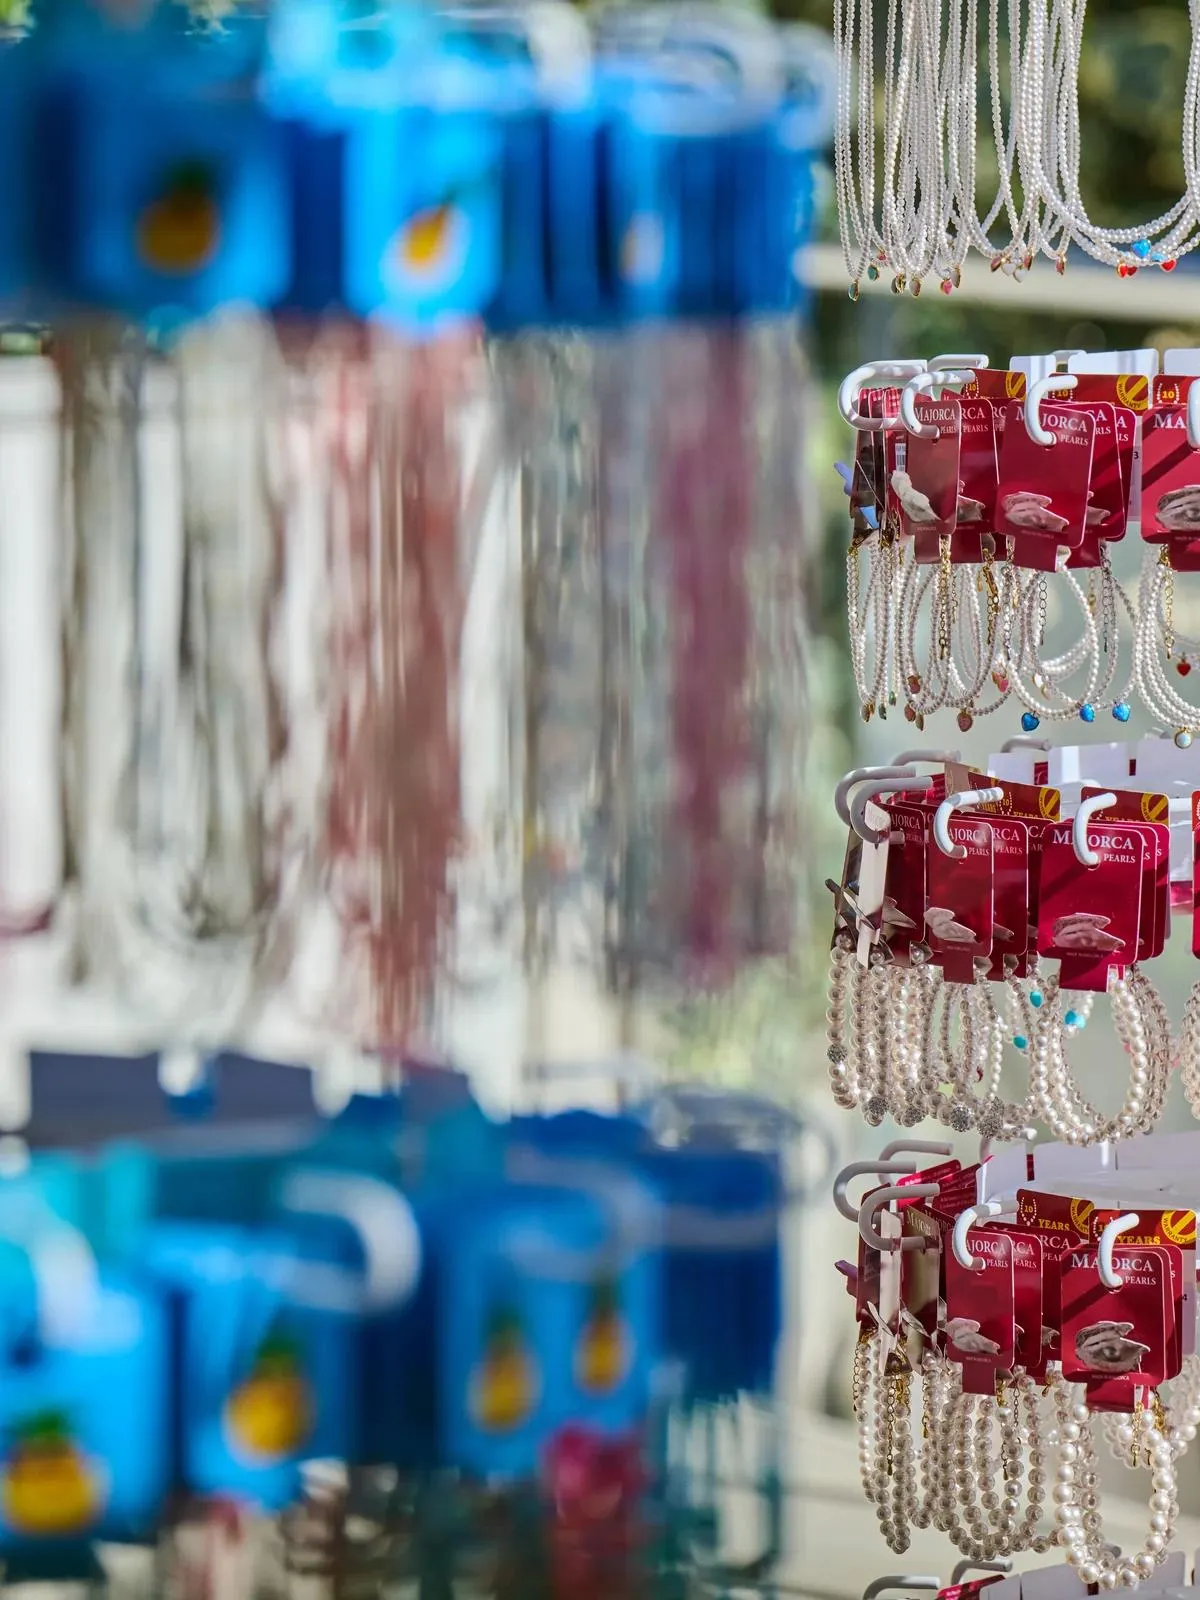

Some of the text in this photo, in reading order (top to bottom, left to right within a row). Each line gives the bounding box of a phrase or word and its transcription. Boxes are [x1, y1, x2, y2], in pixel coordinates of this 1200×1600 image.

[1162, 391, 1175, 399] 10
[1016, 406, 1087, 433] MJORCA
[1060, 433, 1089, 446] PEARLS
[891, 812, 921, 830] AJORCA
[949, 828, 988, 843] AJORCA
[1053, 829, 1134, 850] MORCA
[968, 847, 990, 856] PEARLS
[1103, 853, 1136, 863] PEARLS
[1024, 1205, 1070, 1231] 10 YEARS
[1163, 1218, 1189, 1243] WARRANTY
[1118, 1236, 1160, 1245] YEARS
[987, 1259, 1009, 1268] PEARLS
[1071, 1253, 1153, 1272] MAORCA
[1125, 1276, 1157, 1285] PEARLS
